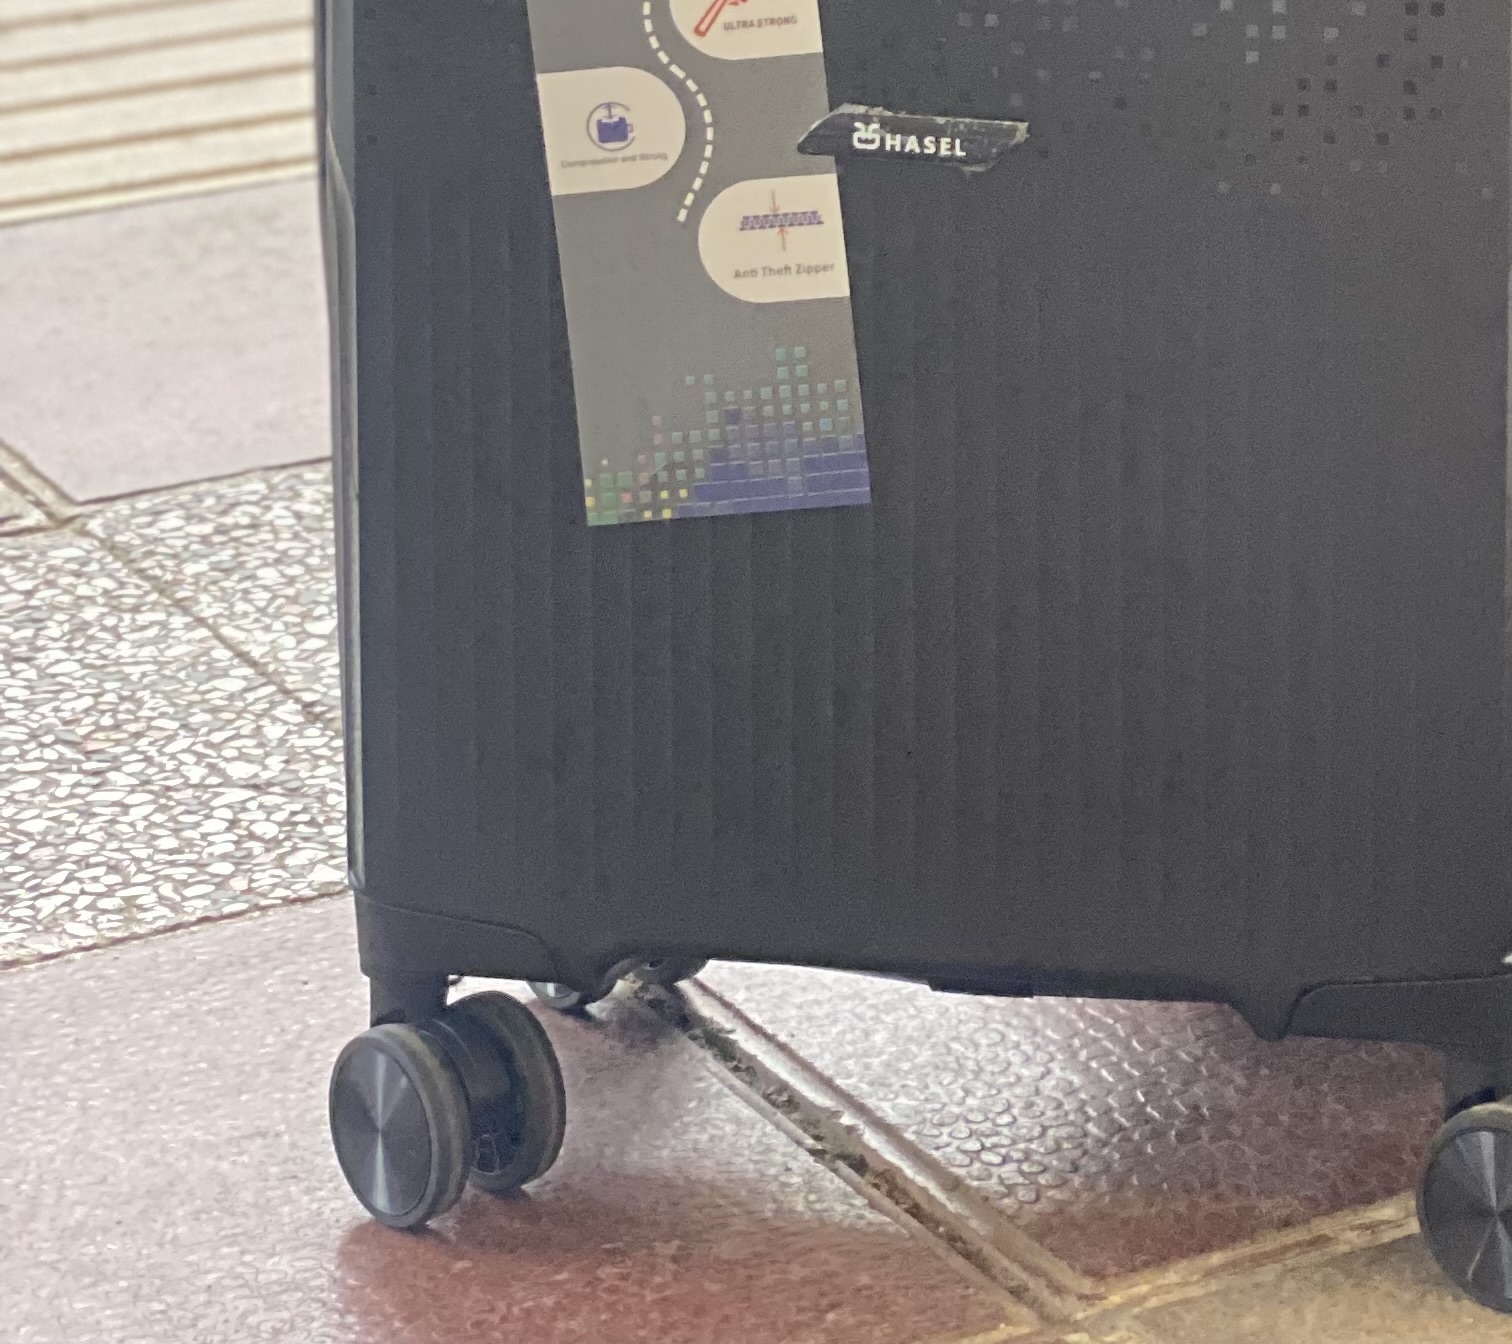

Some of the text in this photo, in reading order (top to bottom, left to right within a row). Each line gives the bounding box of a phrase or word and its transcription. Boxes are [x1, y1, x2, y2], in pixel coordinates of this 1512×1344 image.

[723, 15, 798, 31] ULTRA STRONG
[885, 133, 967, 157] HASEL
[733, 262, 835, 280] Anti Theft Zipper
